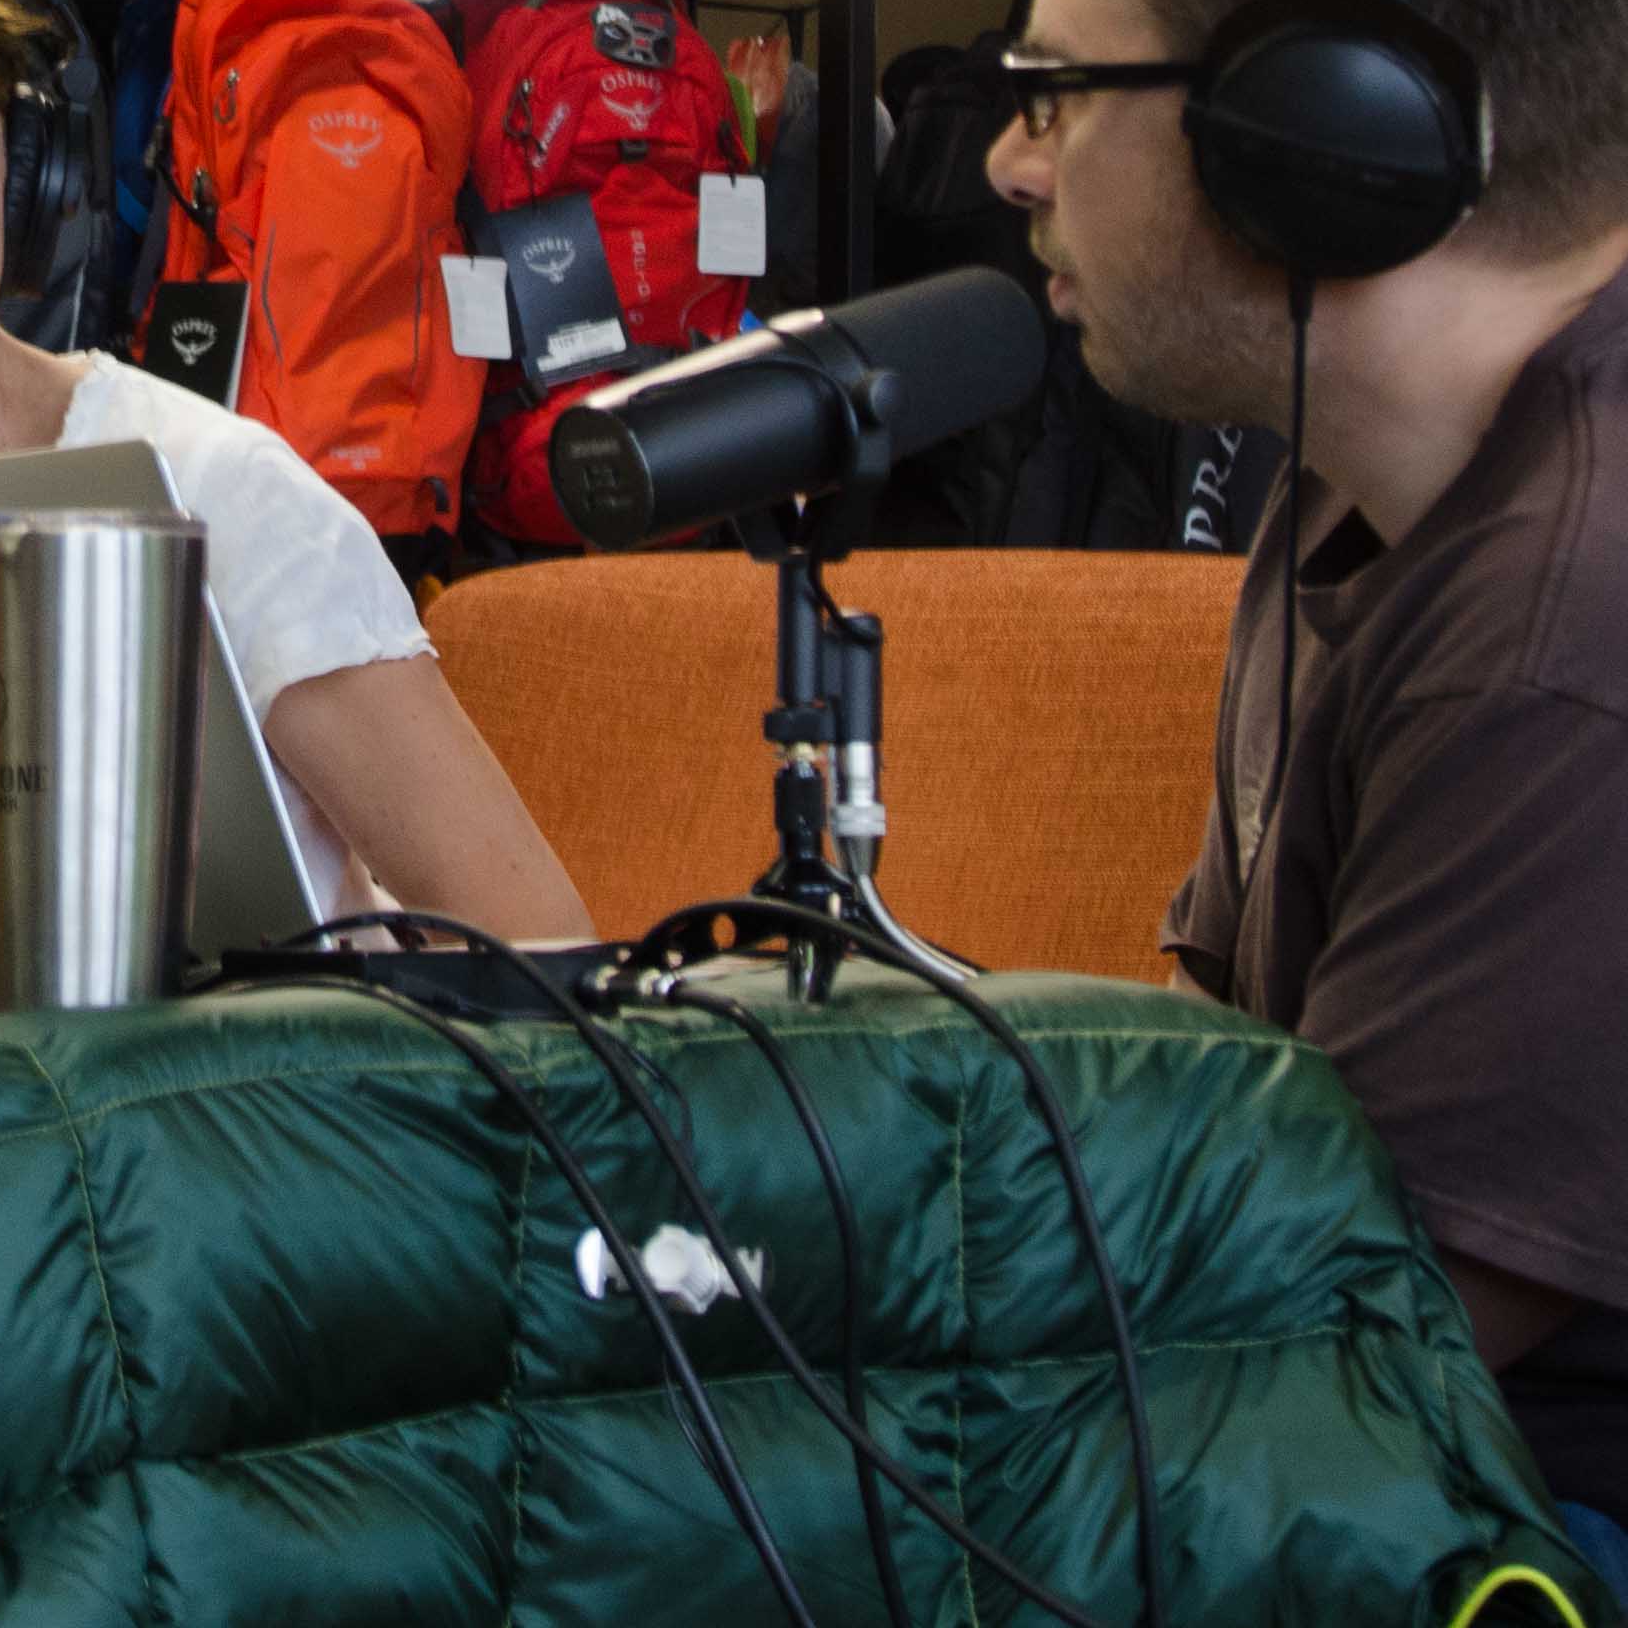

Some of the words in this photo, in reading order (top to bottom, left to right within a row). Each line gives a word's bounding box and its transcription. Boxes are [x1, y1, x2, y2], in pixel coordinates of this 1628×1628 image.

[600, 71, 662, 93] OSPREY
[308, 112, 379, 132] OSPREY
[523, 237, 573, 261] OSPREY
[172, 318, 217, 340] OSPREY
